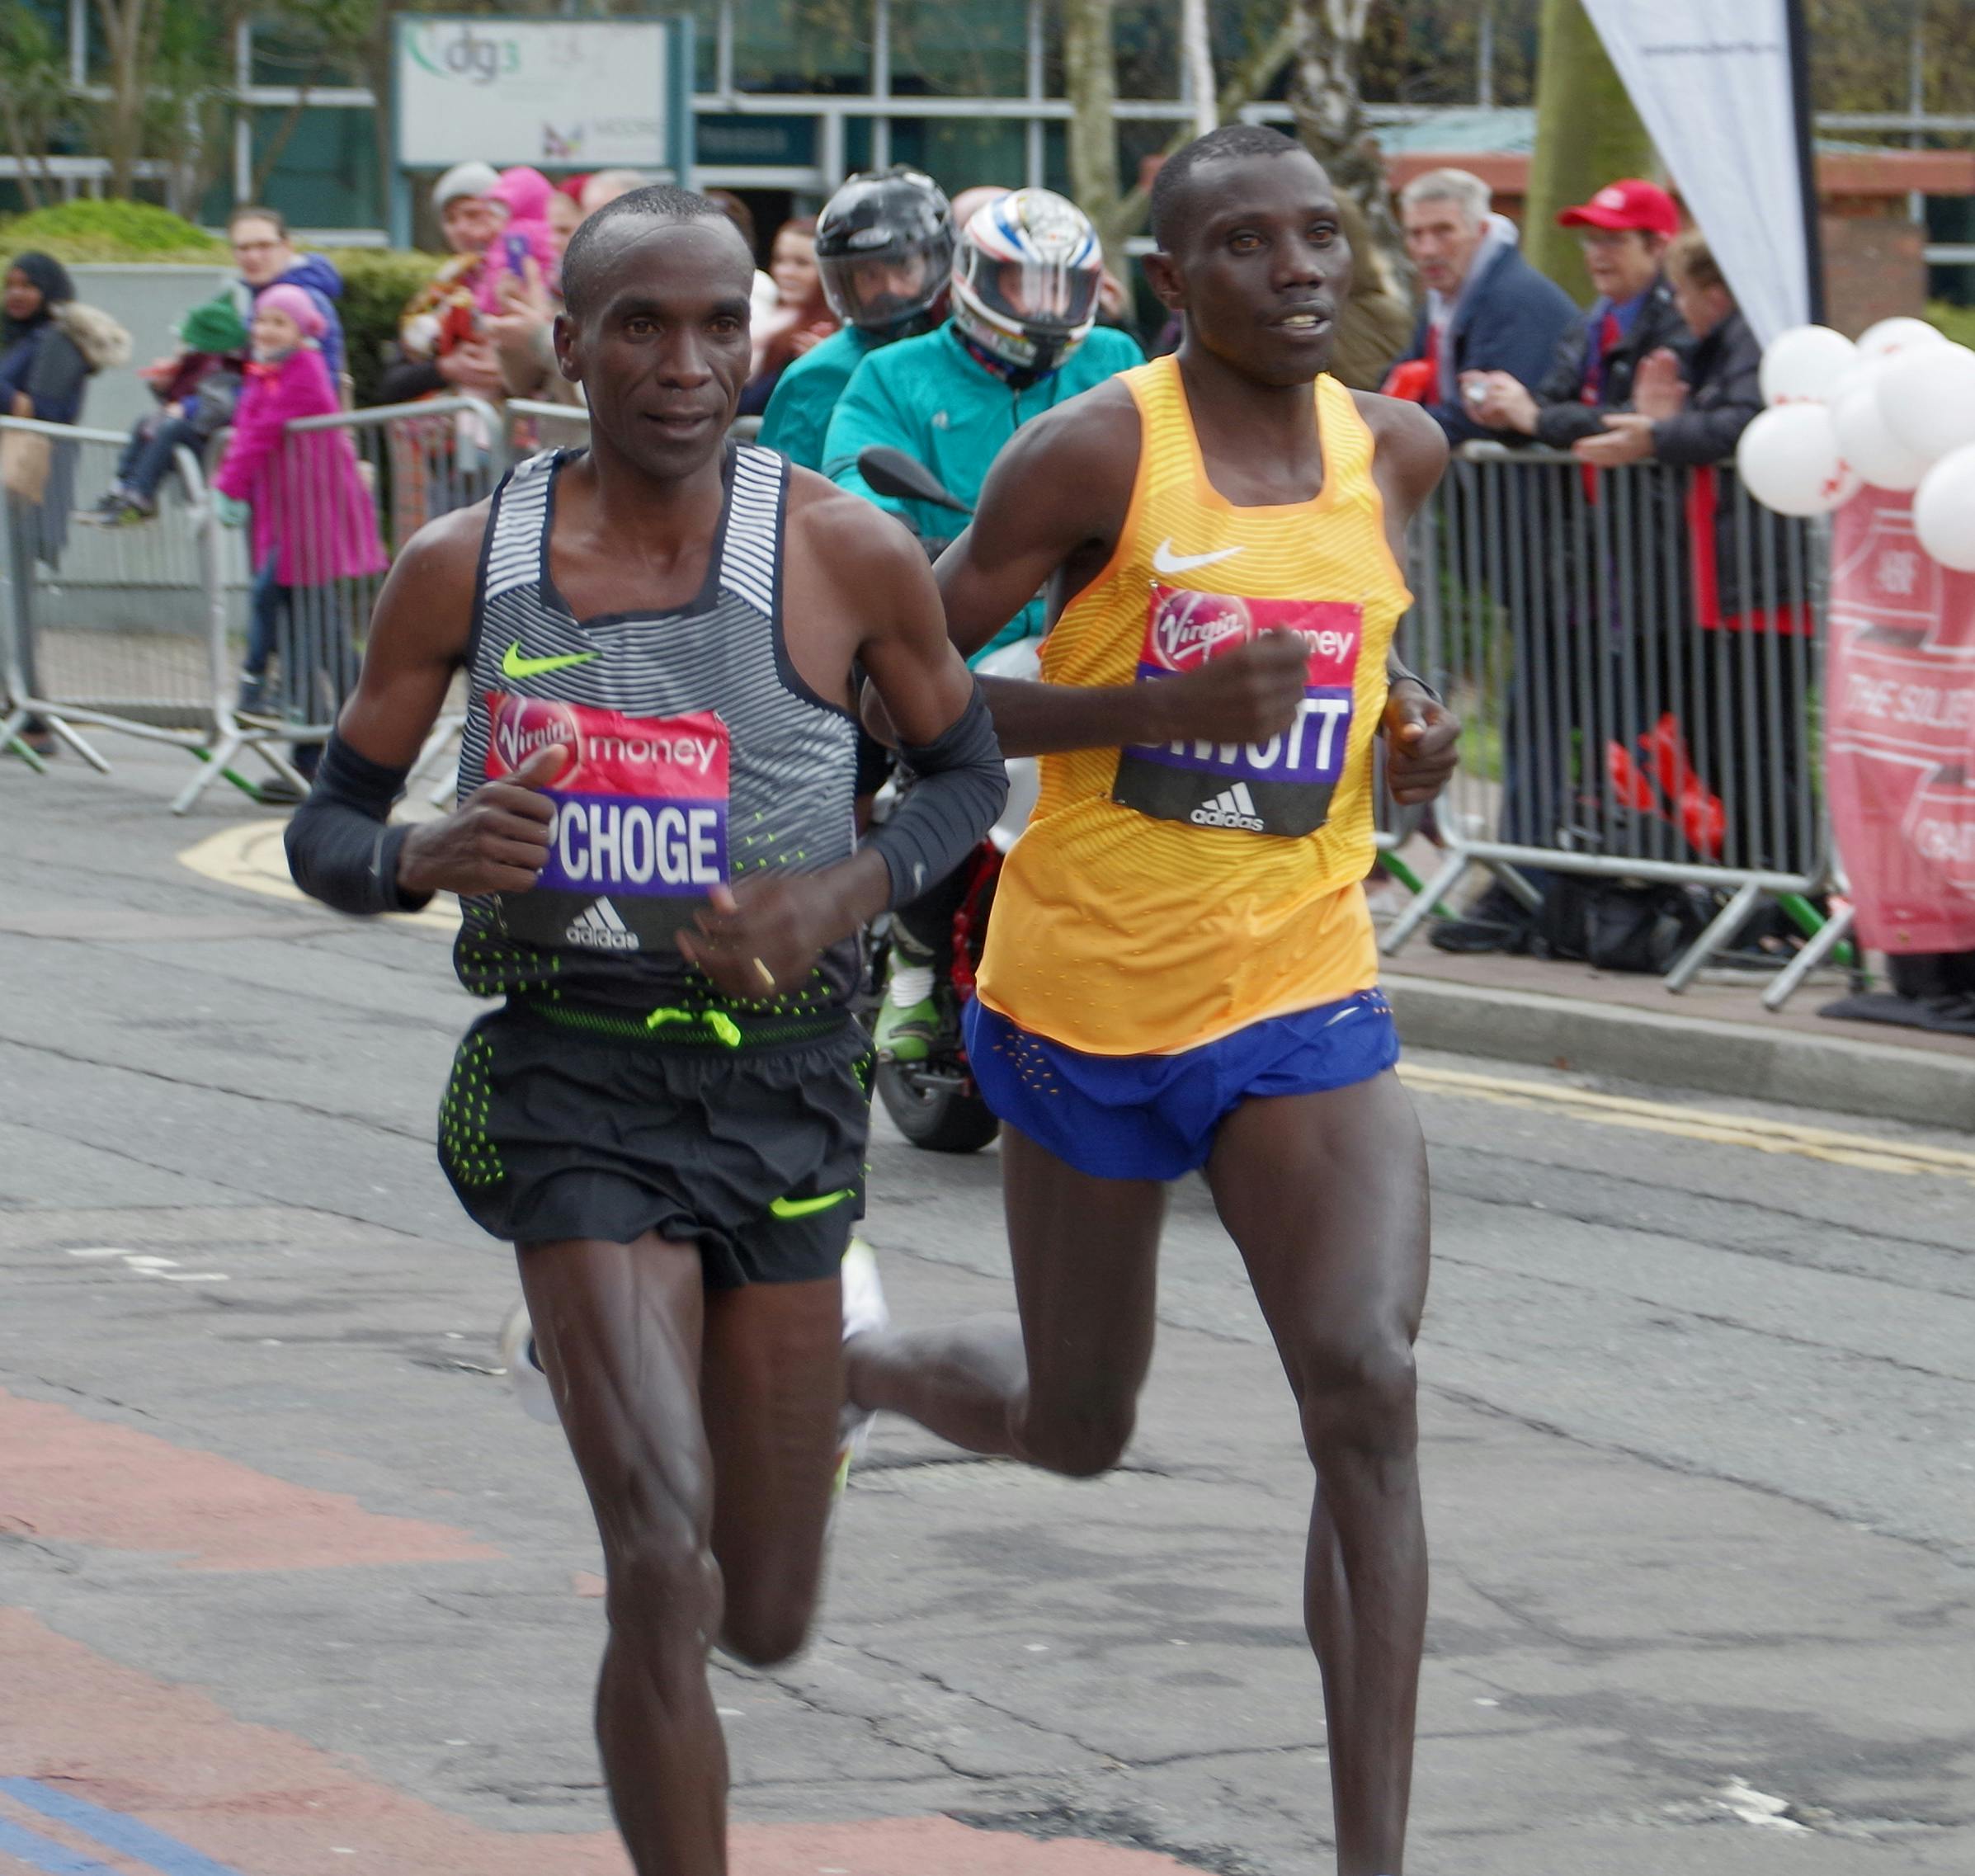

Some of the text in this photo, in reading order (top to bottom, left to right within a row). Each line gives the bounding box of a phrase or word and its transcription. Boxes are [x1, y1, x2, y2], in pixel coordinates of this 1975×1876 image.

[1159, 594, 1355, 664] Virgin ney
[498, 697, 719, 775] Virgin money
[538, 800, 720, 885] CHOGE
[1190, 808, 1265, 832] adidas
[565, 925, 640, 950] adidas
